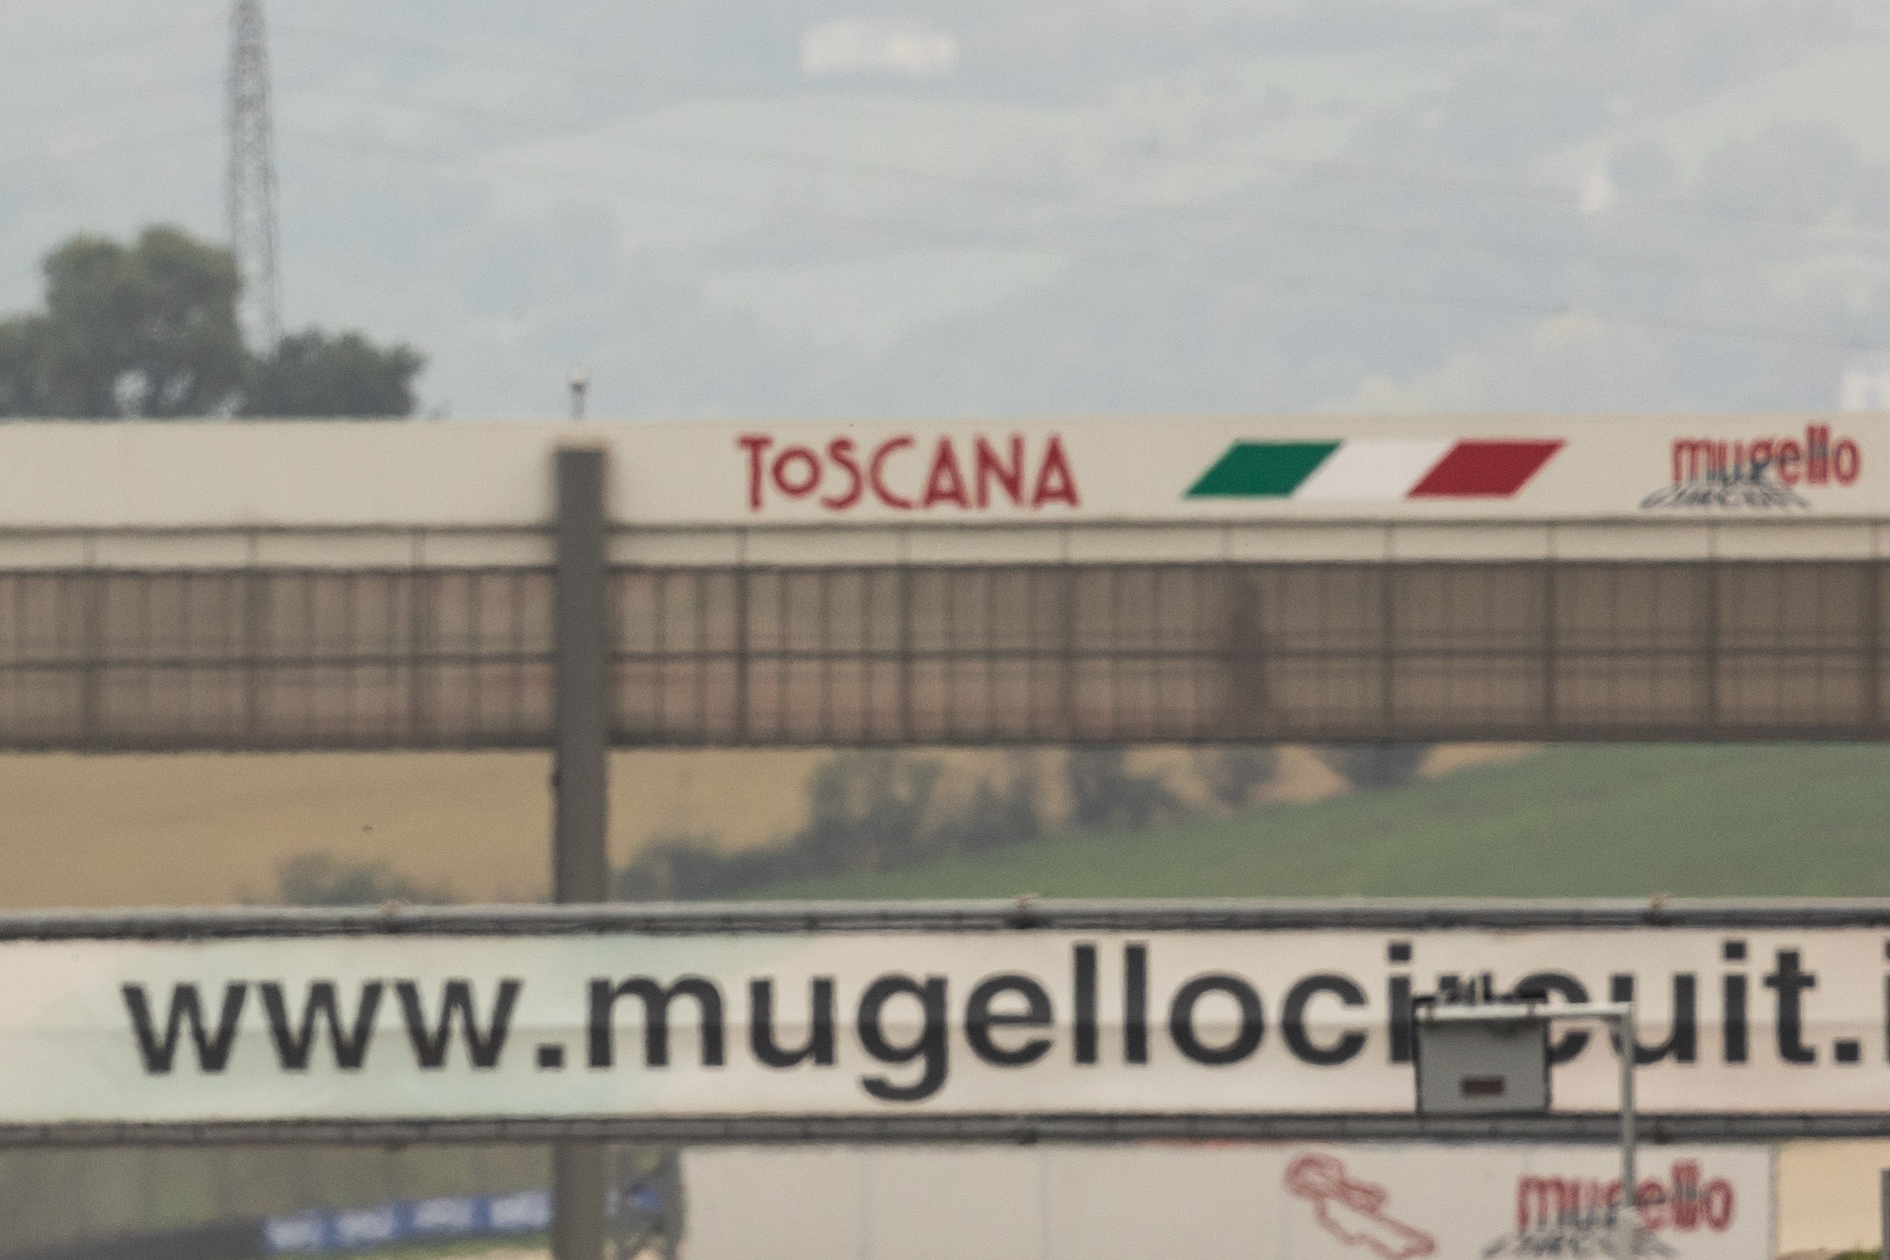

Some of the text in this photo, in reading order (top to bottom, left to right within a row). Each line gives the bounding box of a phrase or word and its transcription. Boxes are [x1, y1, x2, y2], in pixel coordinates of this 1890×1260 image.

[736, 434, 1082, 511] TOSCANA
[1671, 421, 1862, 487] mugello
[121, 940, 1890, 1101] www.mugellocicuit.
